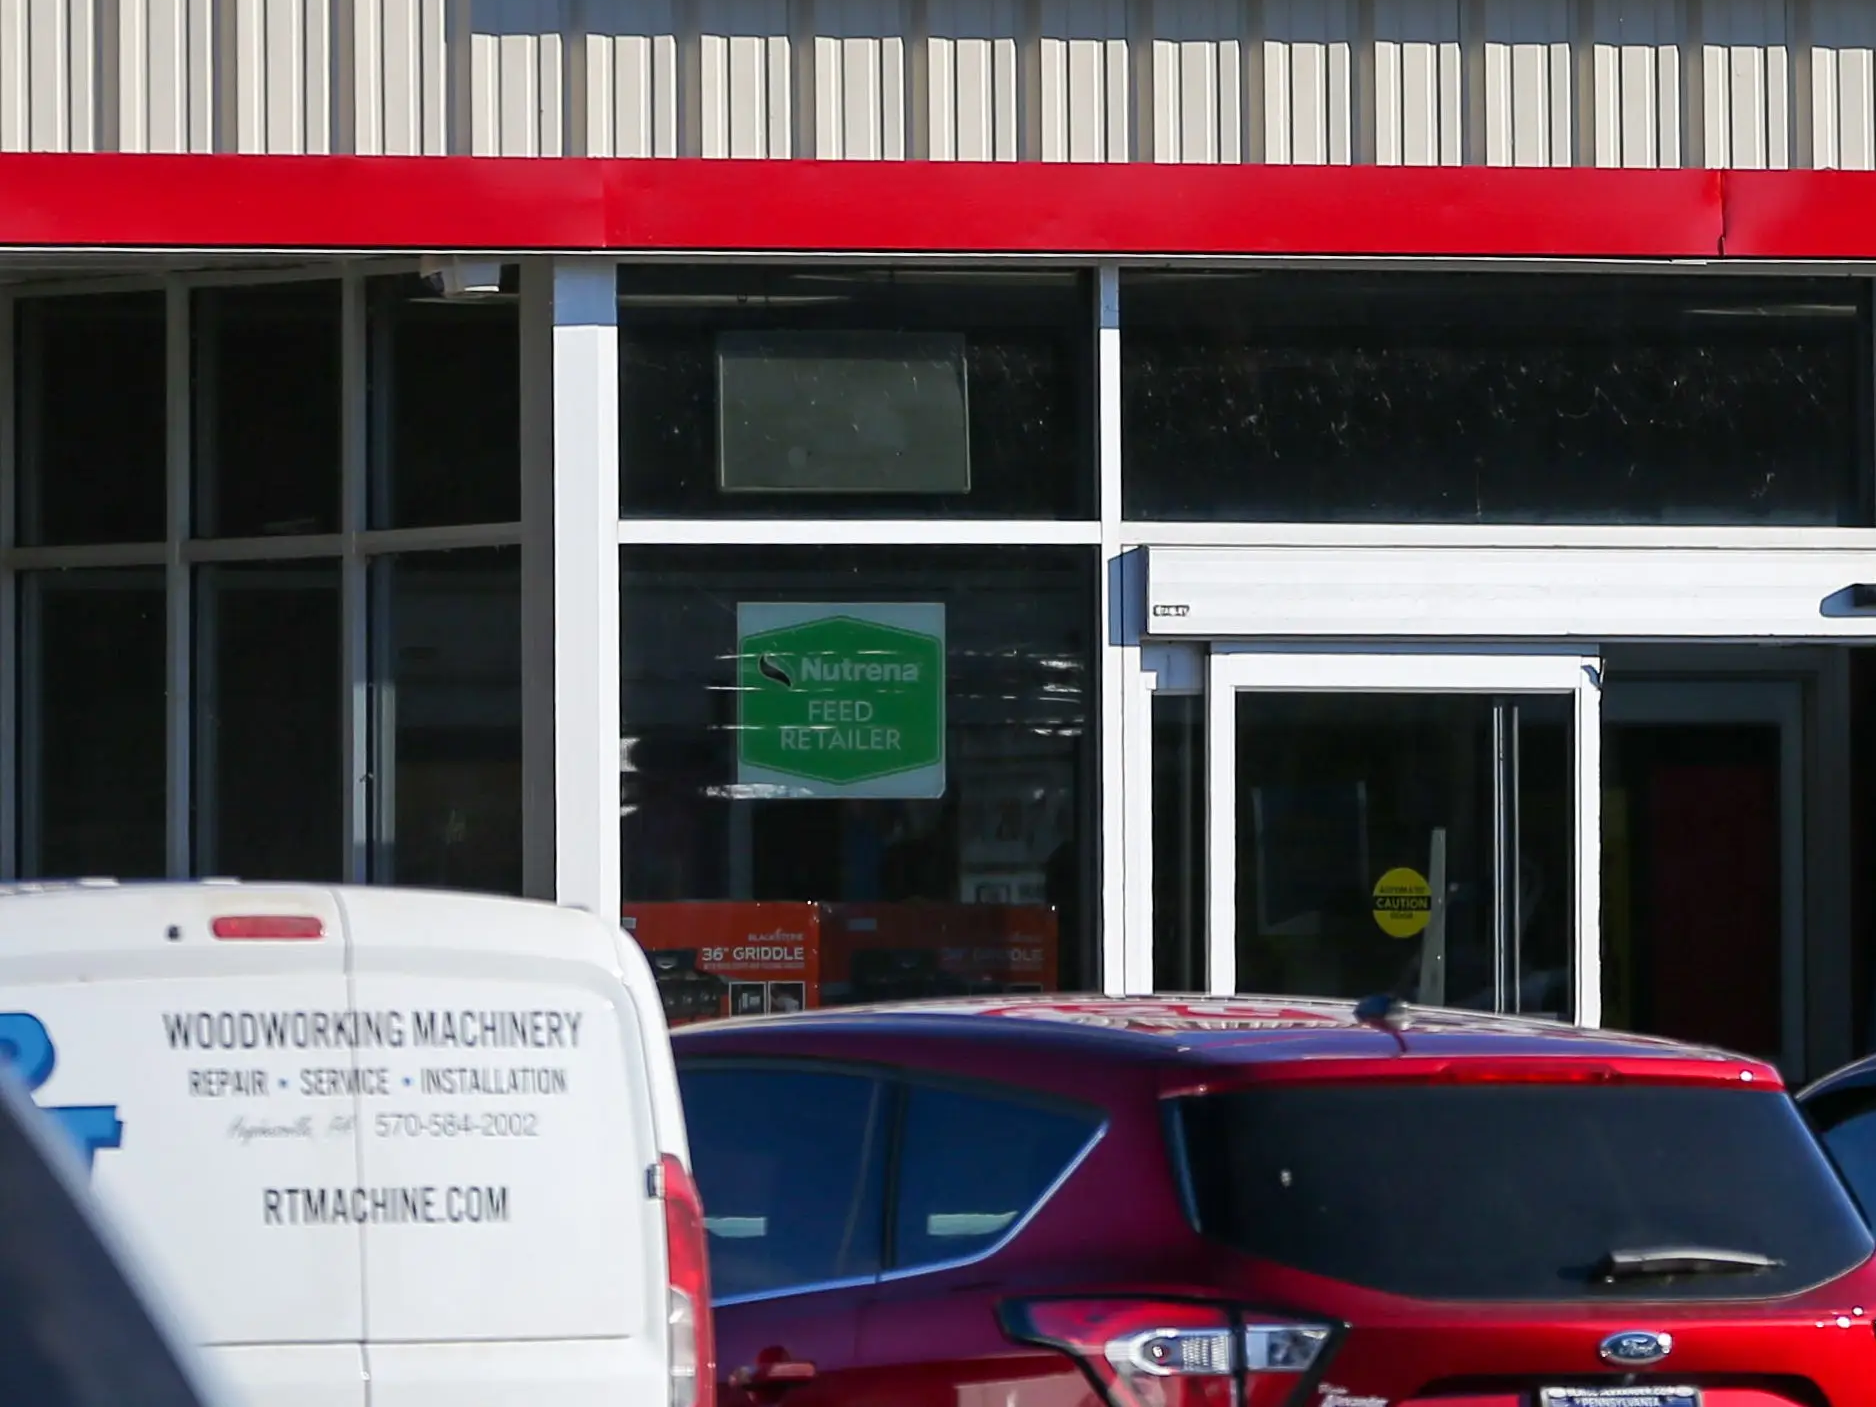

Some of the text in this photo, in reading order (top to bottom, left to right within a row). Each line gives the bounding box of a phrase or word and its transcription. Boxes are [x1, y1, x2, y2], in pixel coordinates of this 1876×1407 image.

[801, 657, 919, 682] Nutrena
[807, 700, 874, 723] FEED
[779, 728, 902, 751] RETAILER
[1376, 897, 1428, 909] CAUTION
[702, 947, 804, 961] 36" GRIDDLE
[162, 1010, 582, 1049] WOODWORKING MACHINERY
[188, 1067, 568, 1097] REPAIR SERVICE INSTALLATION
[374, 1112, 539, 1138] 570-584-2002
[262, 1186, 510, 1226] RTMACHINE.COM
